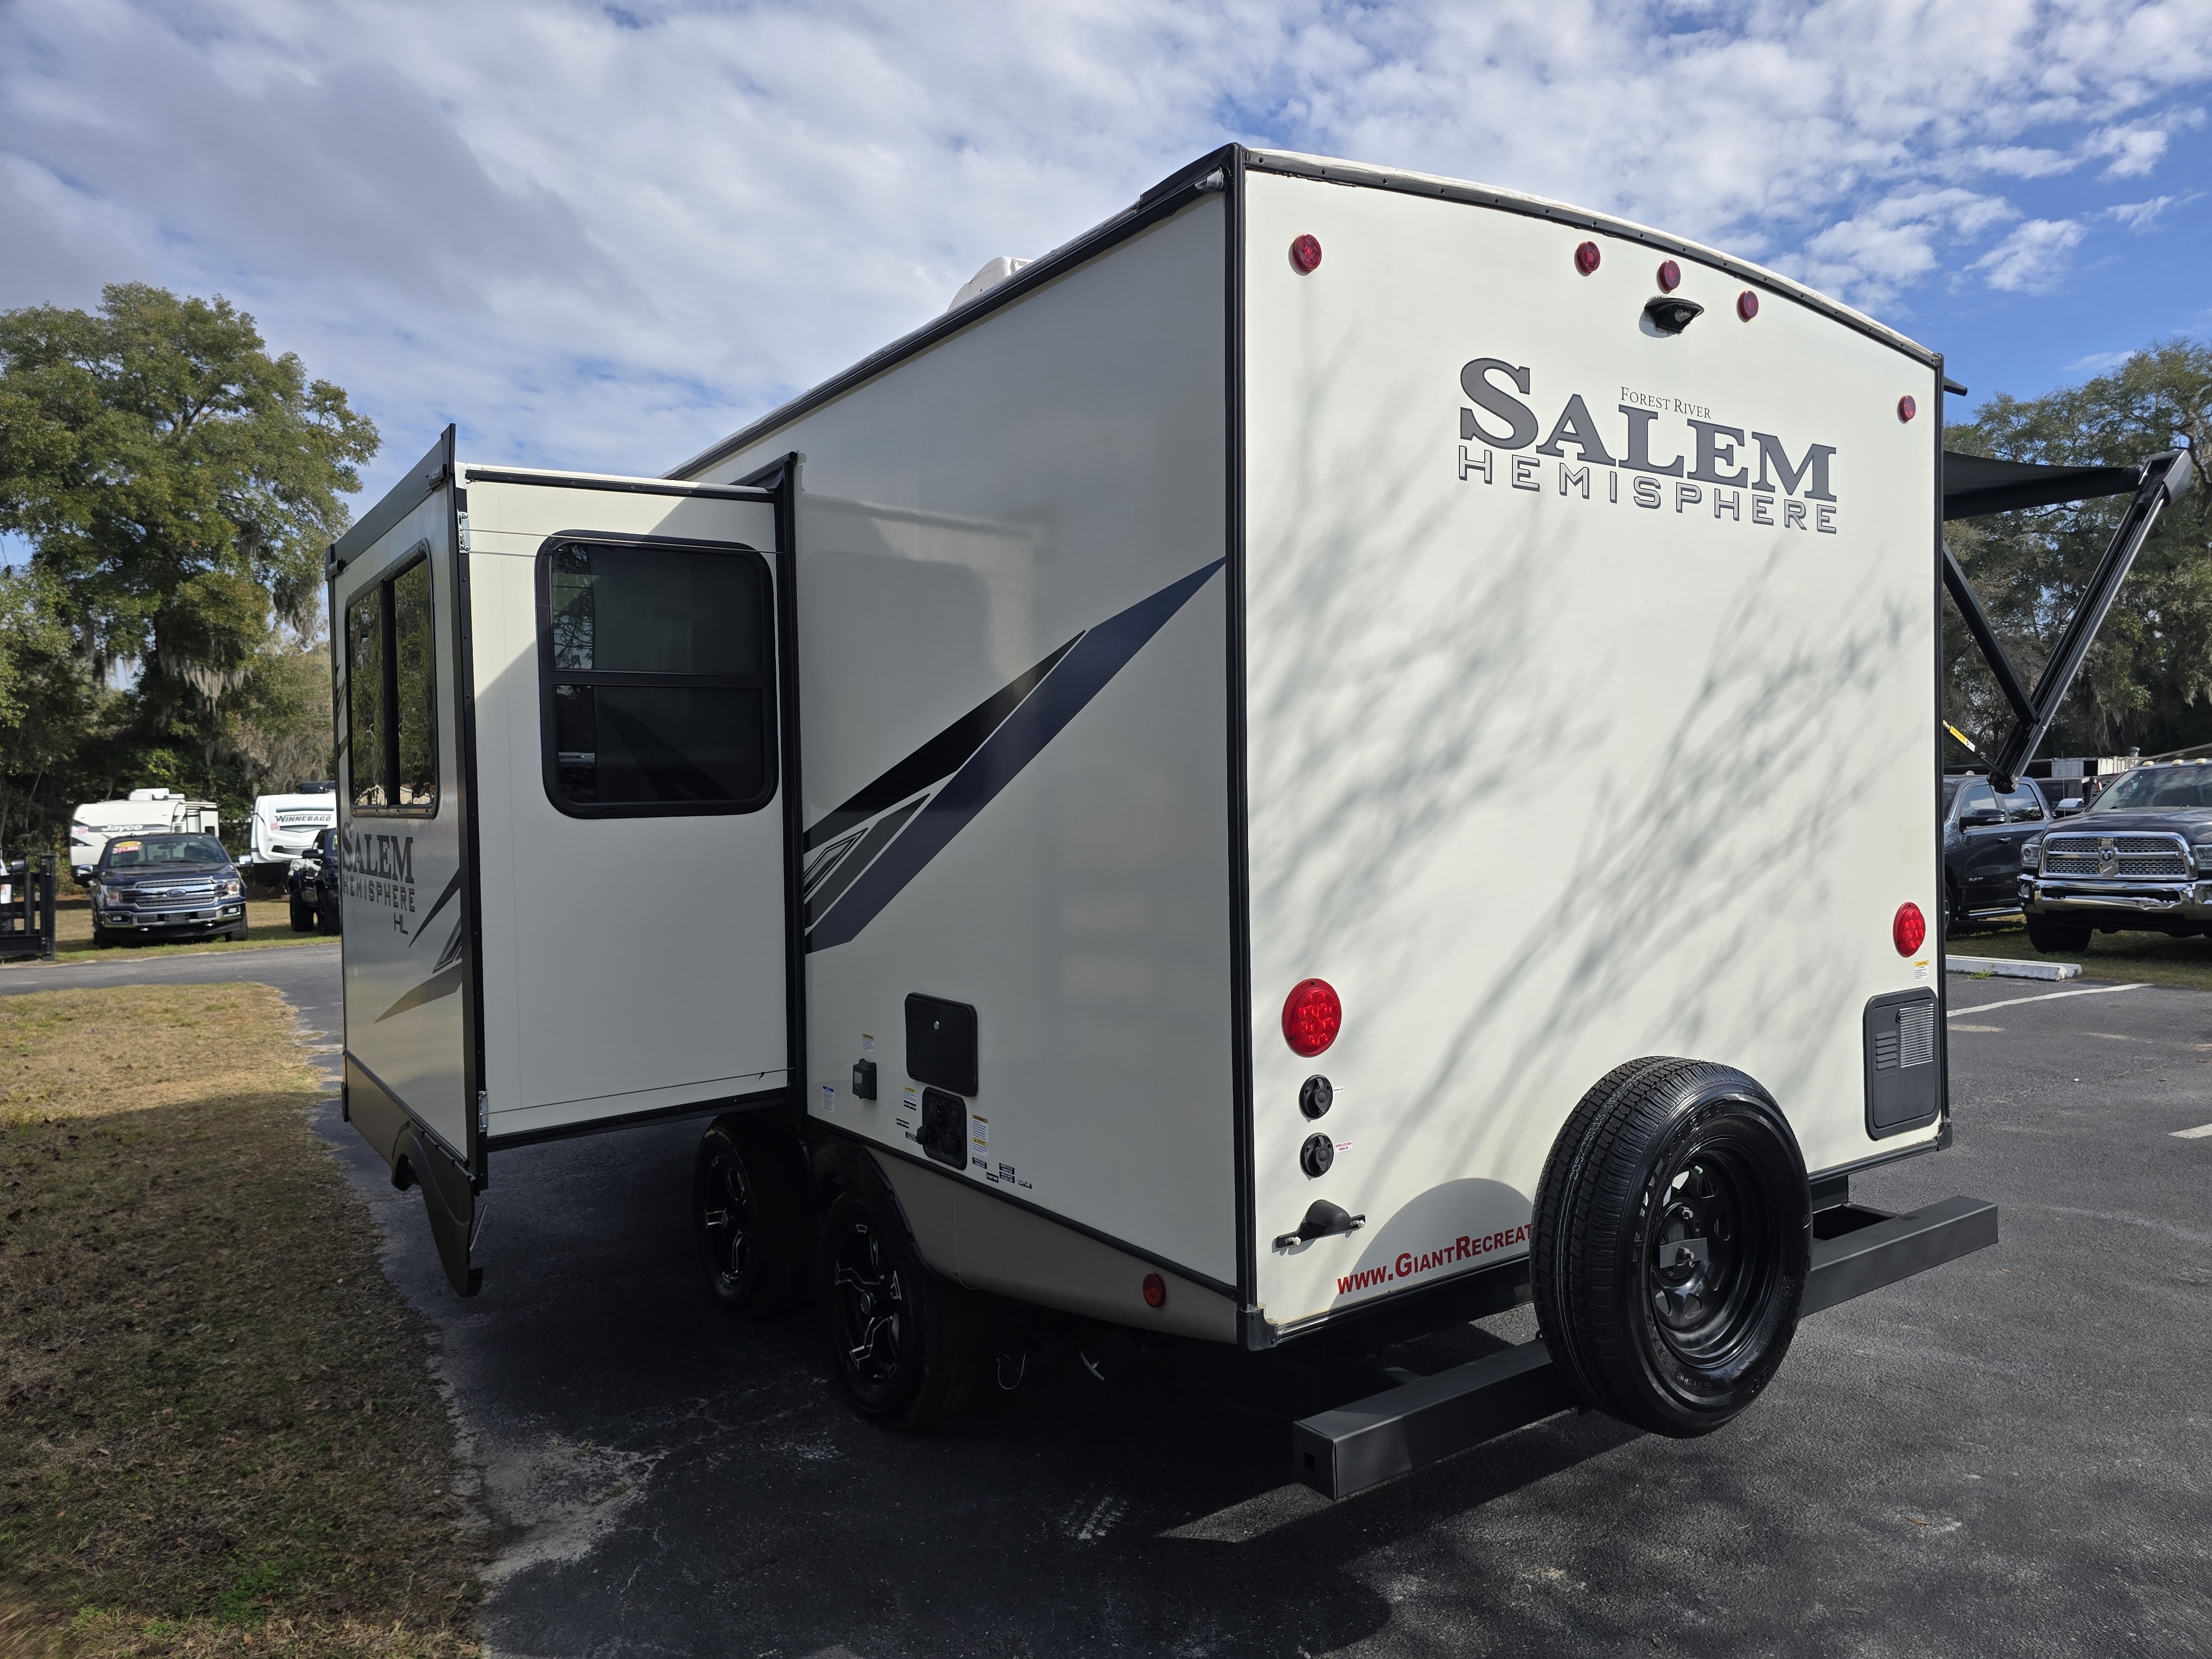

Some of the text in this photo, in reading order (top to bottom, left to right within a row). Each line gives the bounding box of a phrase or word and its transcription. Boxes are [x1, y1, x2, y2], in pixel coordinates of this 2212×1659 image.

[1620, 387, 1712, 420] FOREST RIVER
[1460, 357, 1837, 503] SALEM
[1458, 445, 1837, 535] HEMISPHERE
[274, 815, 332, 823] WINNEBAGO
[342, 821, 415, 884] SALEM
[342, 874, 415, 913] HEMISPHERE
[393, 912, 409, 935] HL
